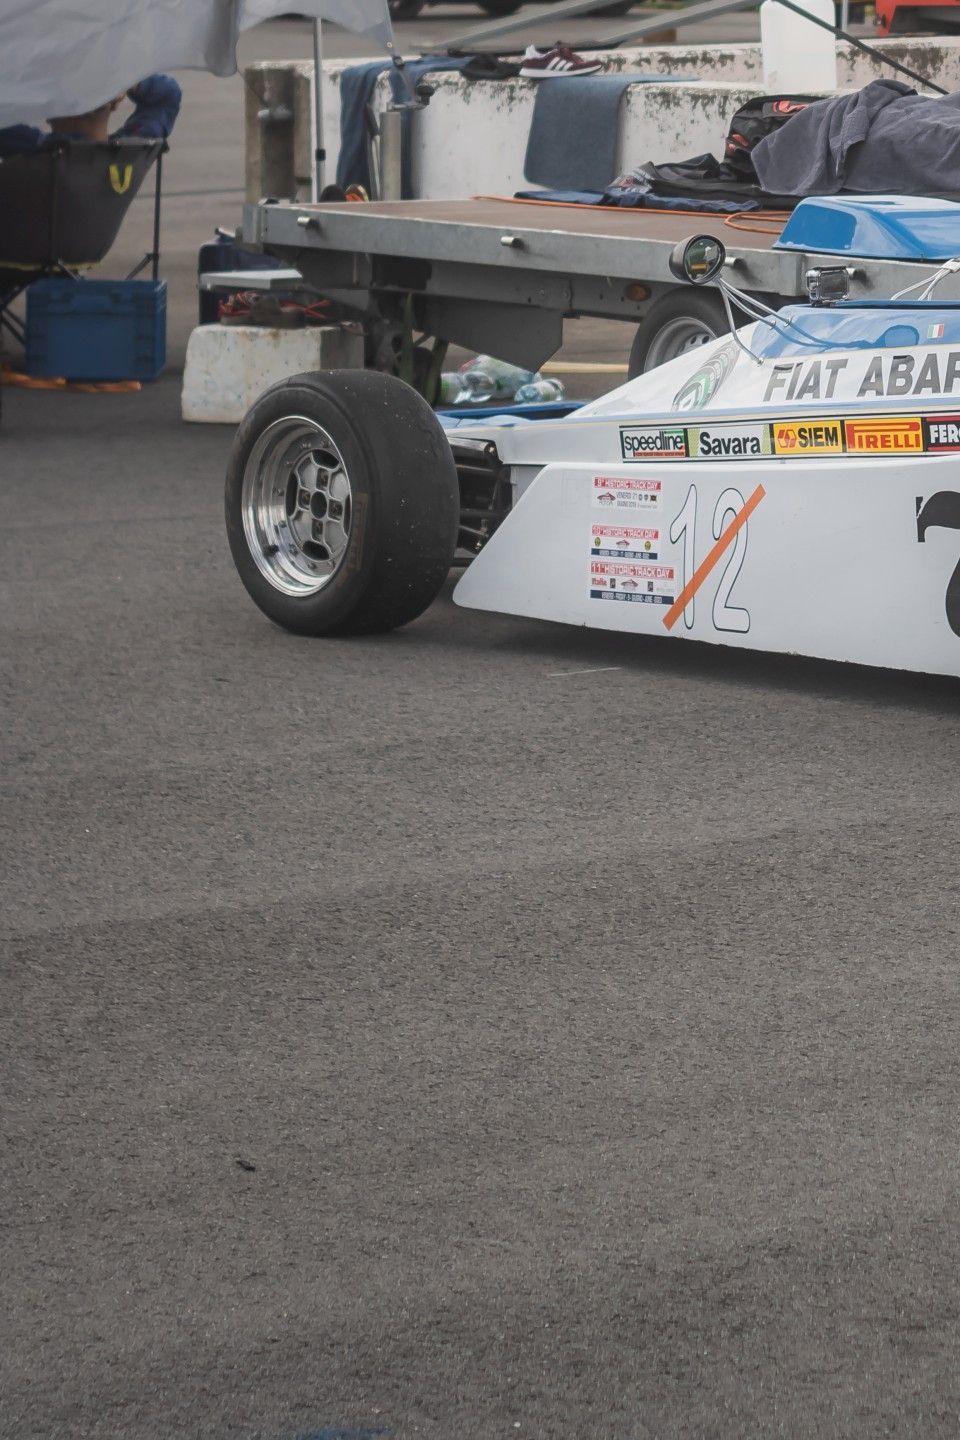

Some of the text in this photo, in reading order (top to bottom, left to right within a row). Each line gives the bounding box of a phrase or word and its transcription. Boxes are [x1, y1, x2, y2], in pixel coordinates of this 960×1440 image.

[763, 359, 849, 402] FIAT
[624, 430, 683, 456] speedline
[700, 432, 761, 455] Savara
[798, 427, 838, 448] SIEM
[845, 422, 920, 449] PIRELLI
[670, 484, 750, 633] 12
[636, 566, 656, 577] TRACK
[657, 568, 669, 578] DAY
